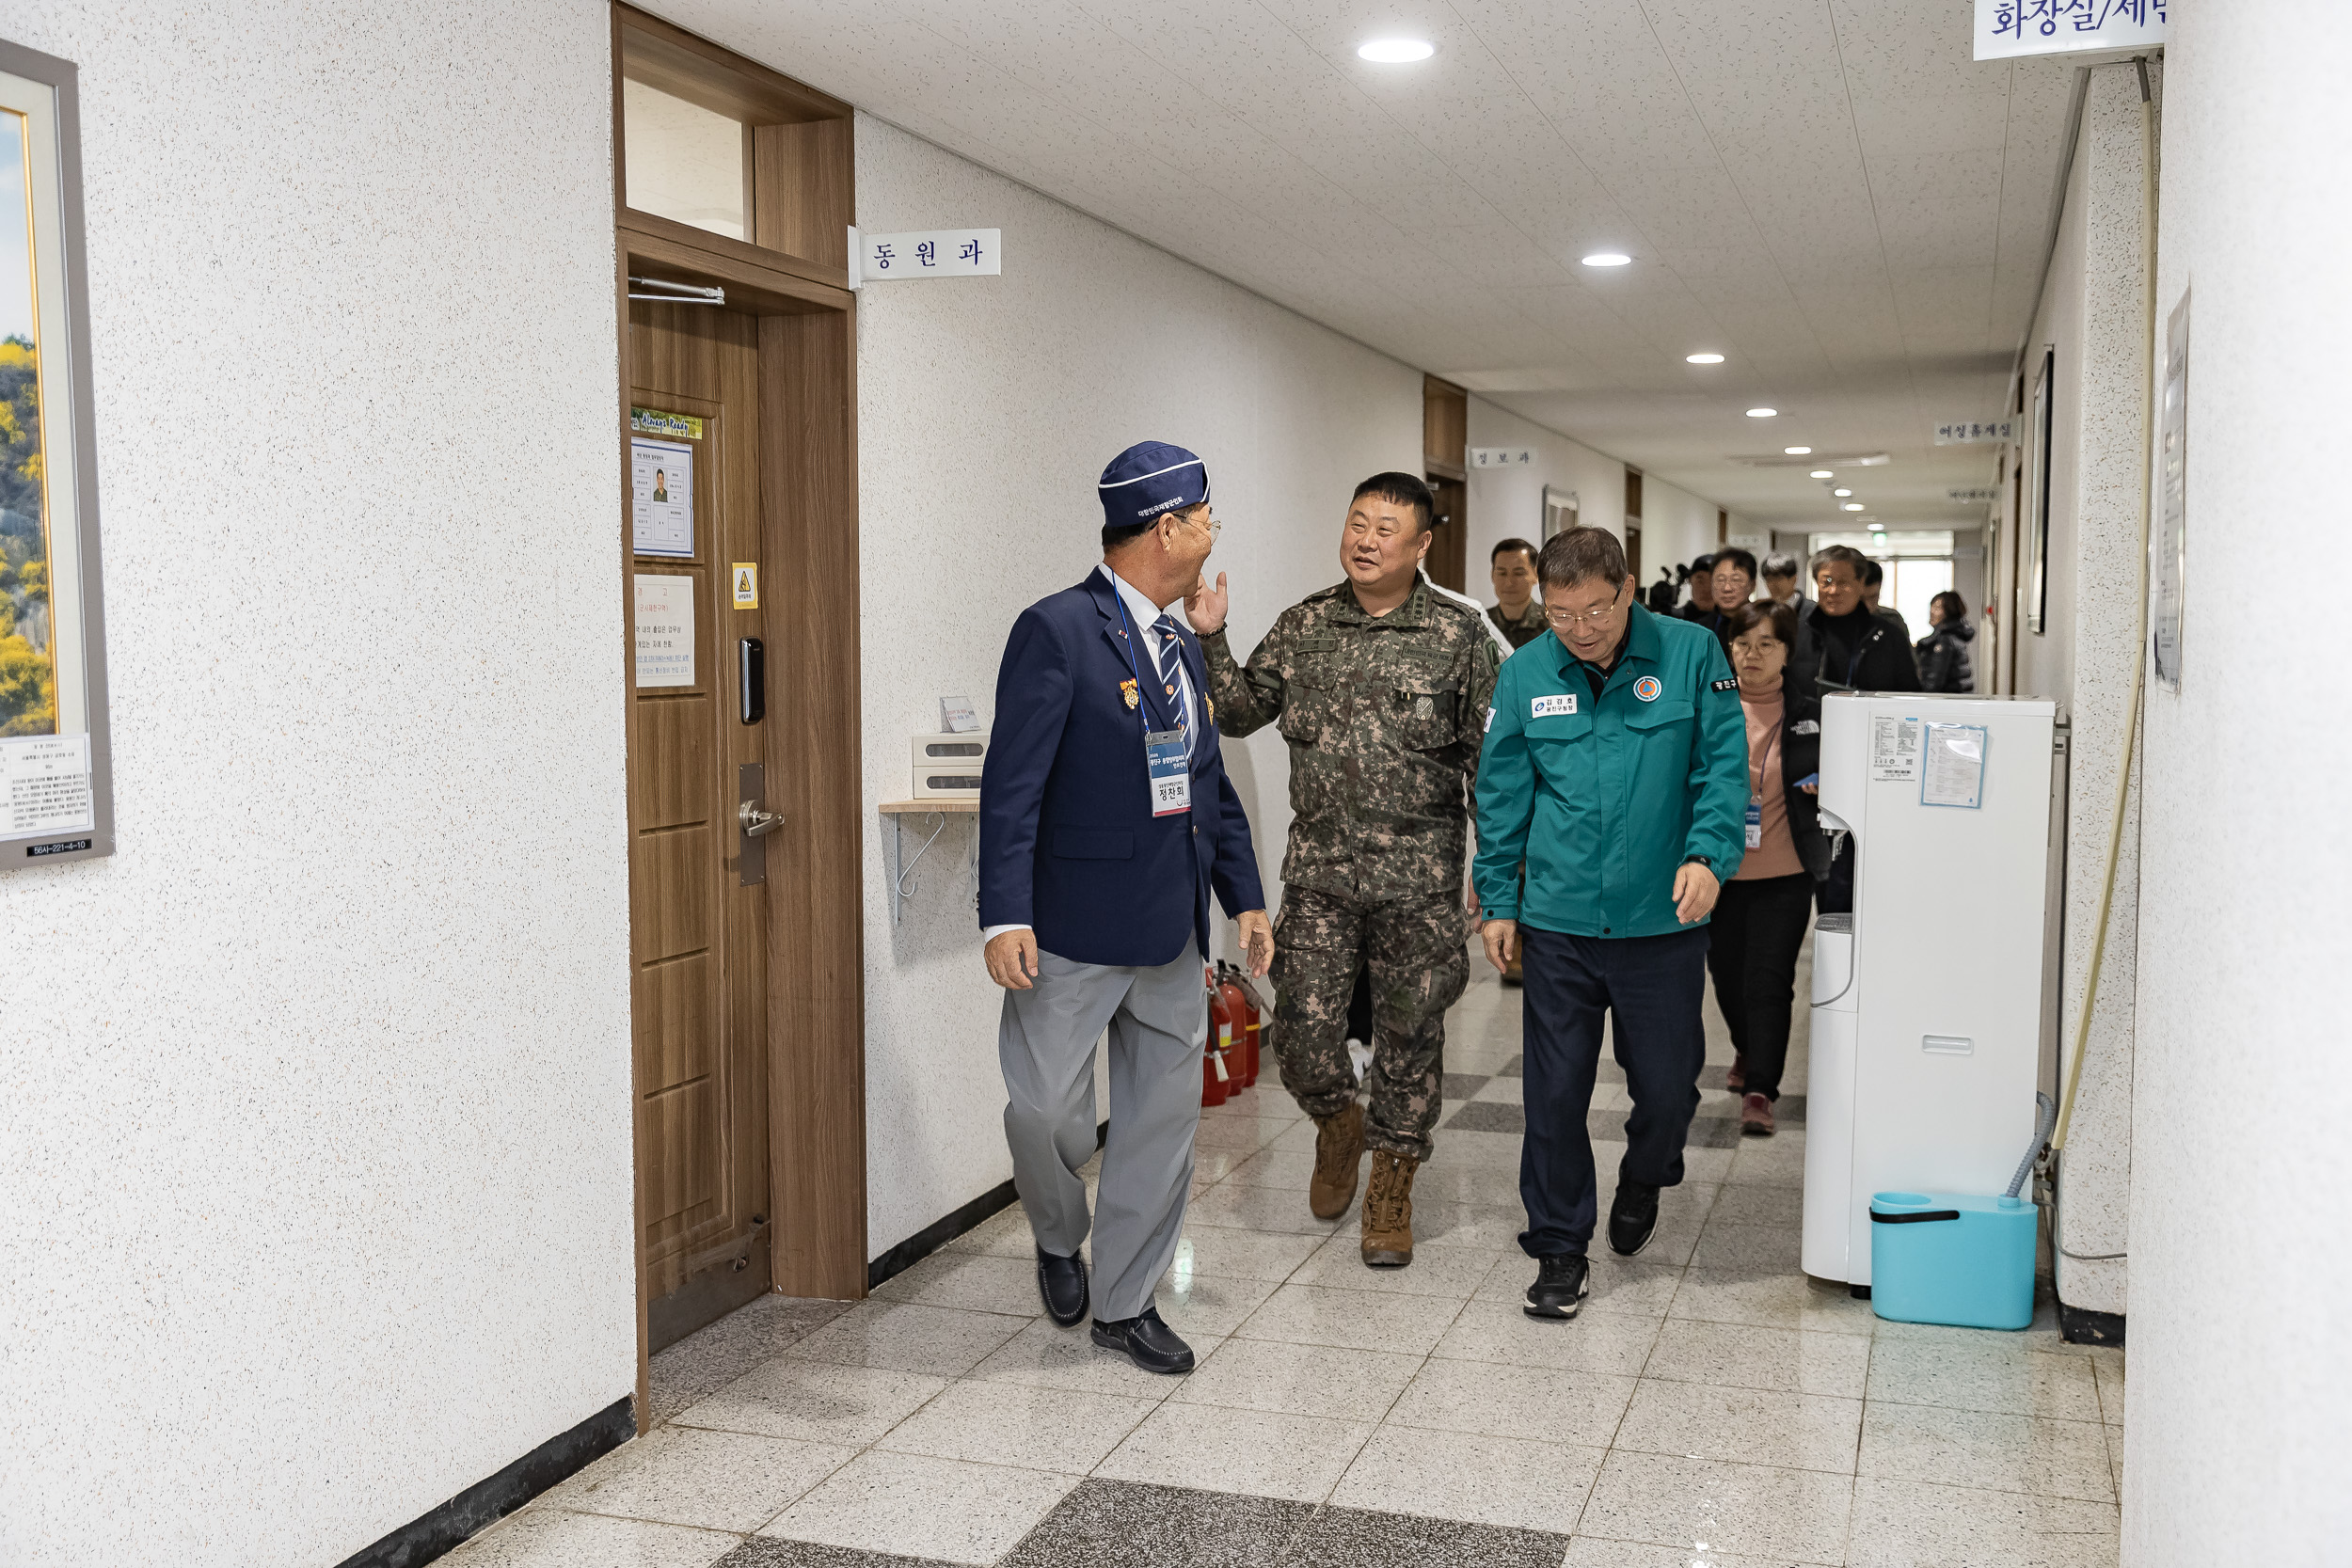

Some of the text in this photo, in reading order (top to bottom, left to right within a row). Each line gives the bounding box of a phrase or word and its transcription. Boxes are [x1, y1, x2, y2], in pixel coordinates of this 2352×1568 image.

[642, 412, 666, 434] Always
[669, 417, 689, 437] Ready
[1715, 679, 1737, 690] 광진구
[34, 841, 86, 854] 56사-221-4-10
